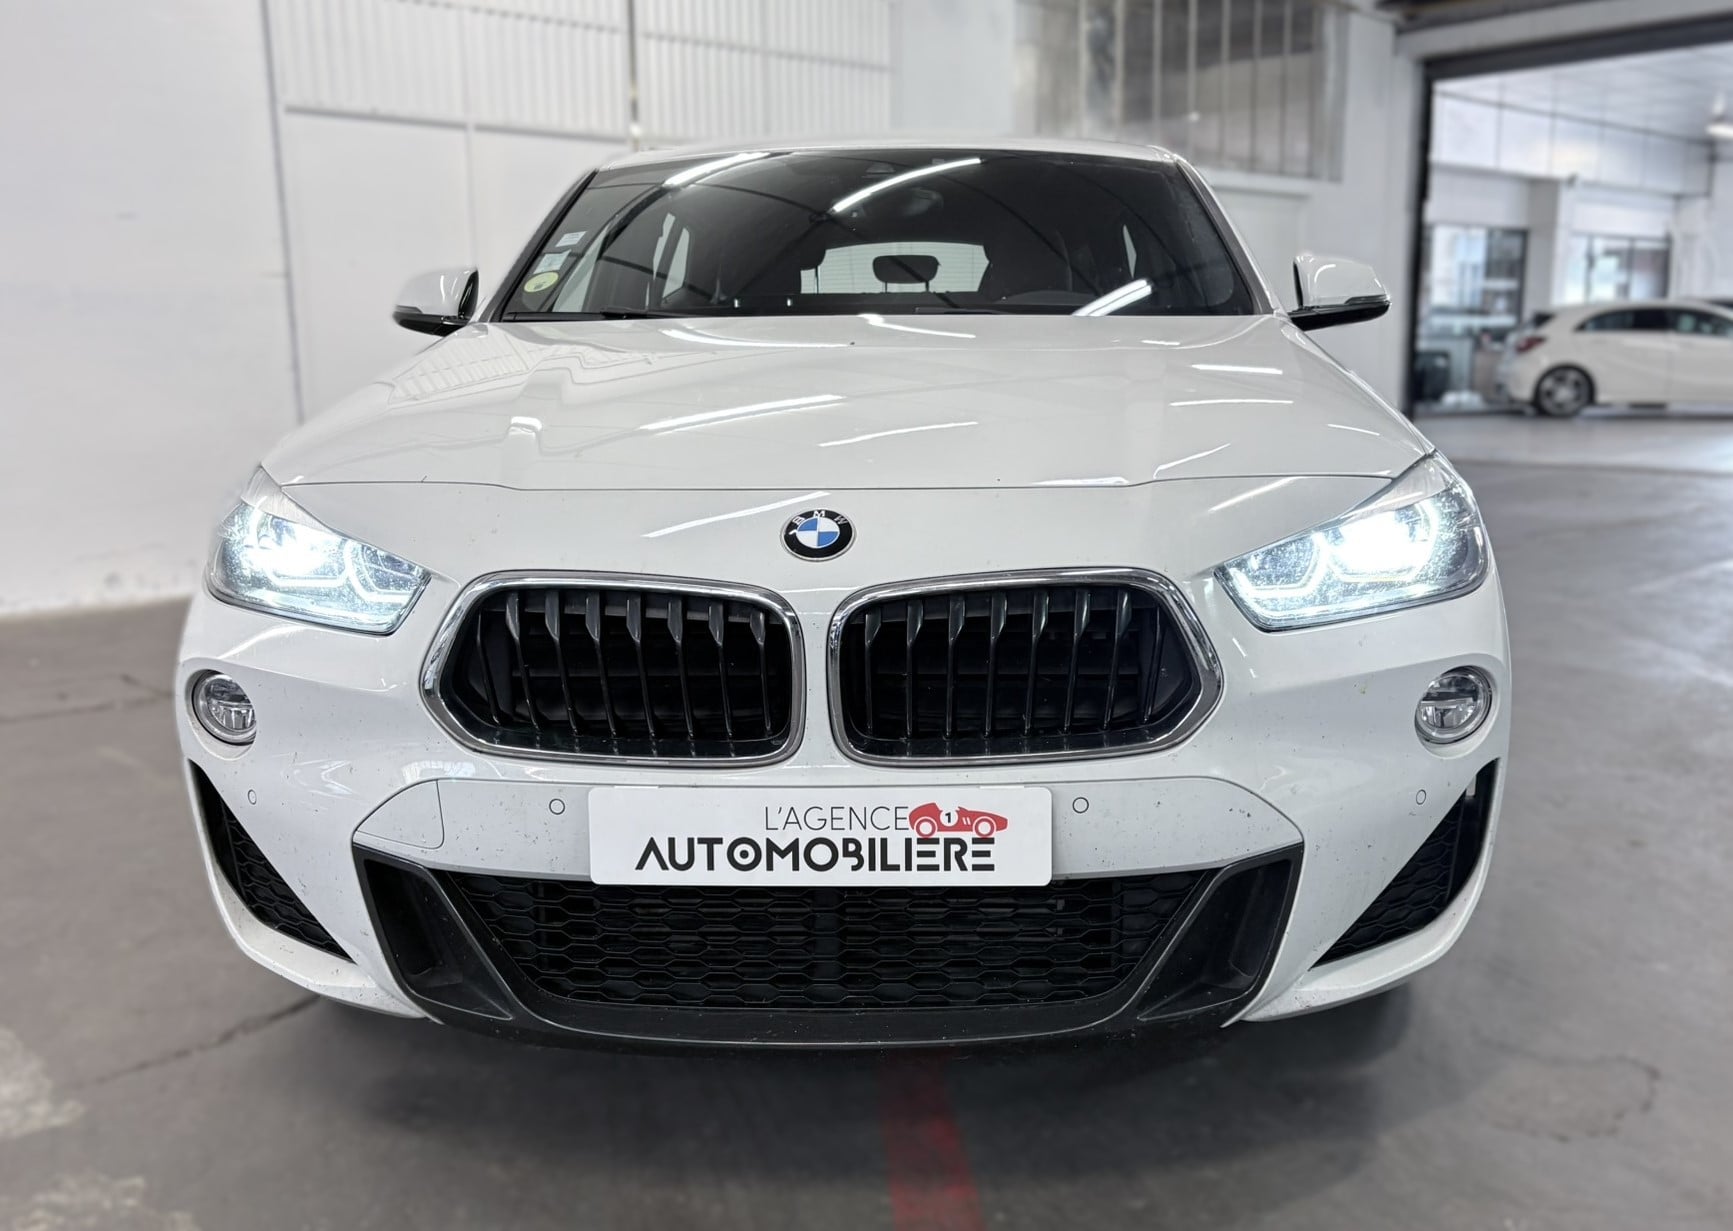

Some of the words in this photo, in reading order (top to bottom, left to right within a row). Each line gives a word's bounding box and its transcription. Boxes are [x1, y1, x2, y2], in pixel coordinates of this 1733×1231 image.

[792, 509, 849, 525] BMW
[765, 806, 909, 831] L'AGENCE
[944, 811, 952, 824] 1
